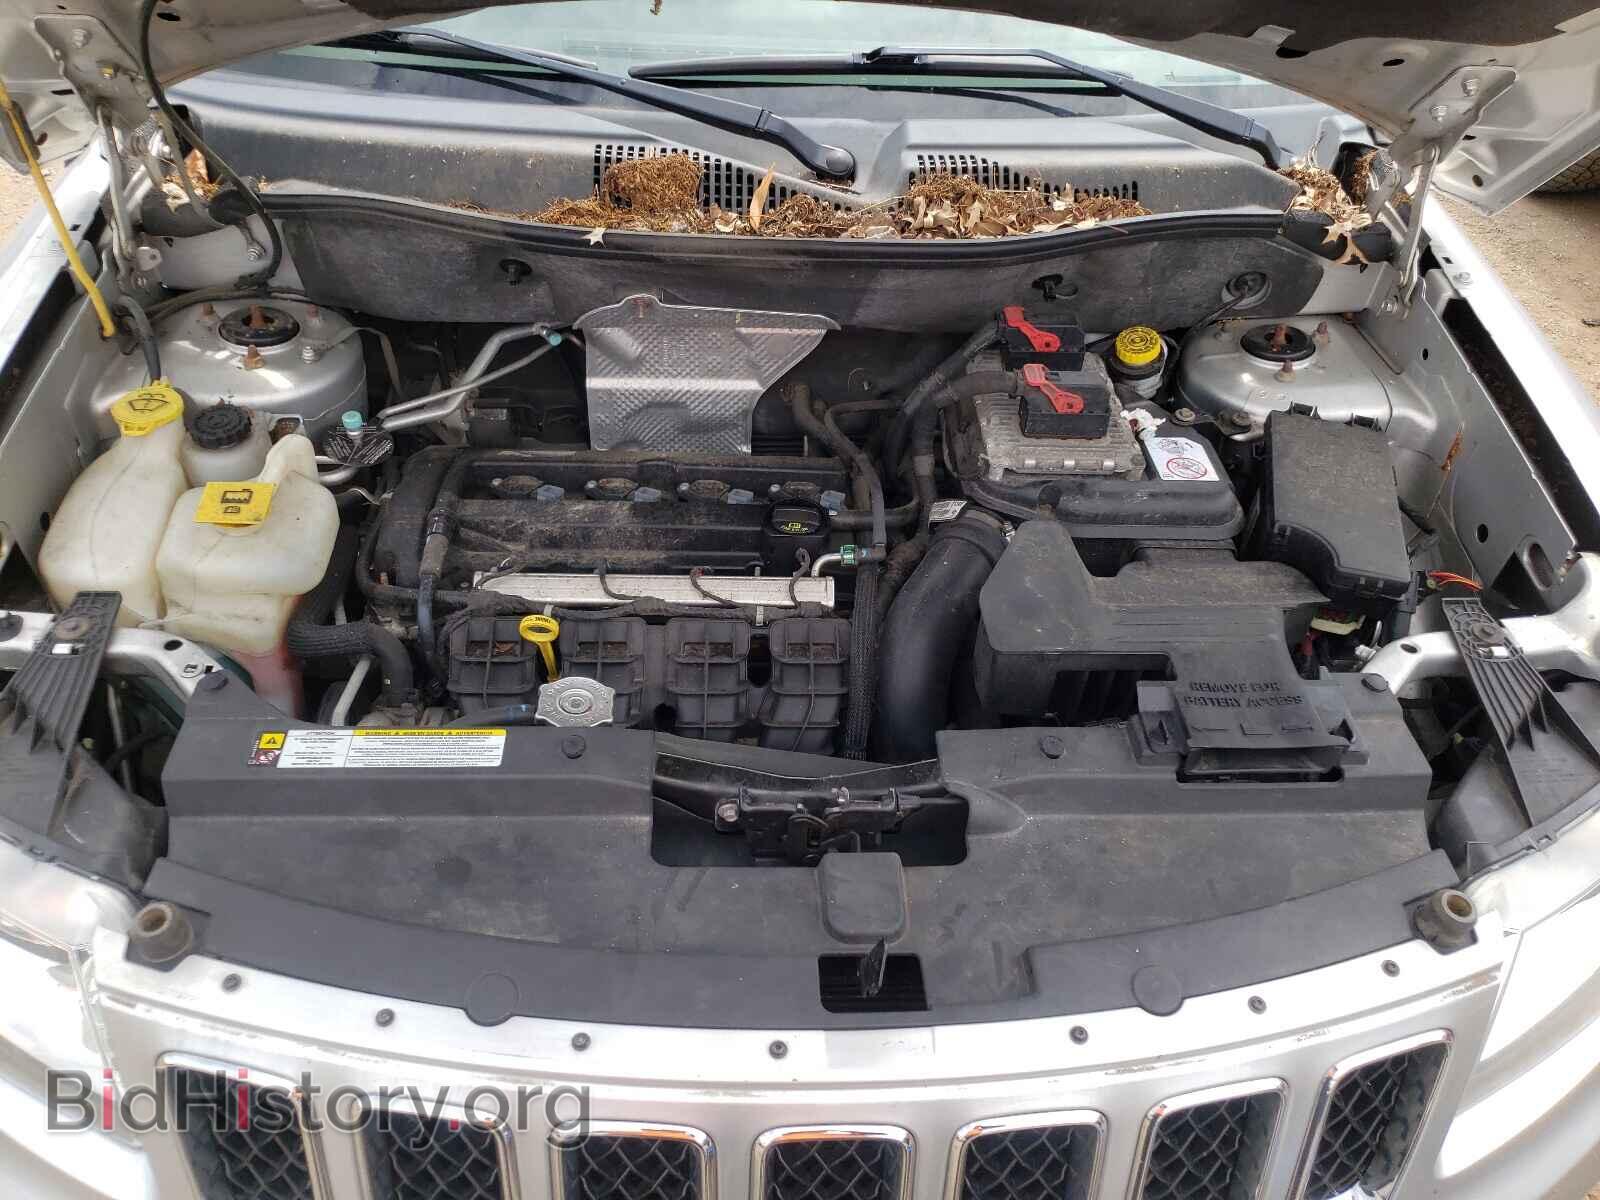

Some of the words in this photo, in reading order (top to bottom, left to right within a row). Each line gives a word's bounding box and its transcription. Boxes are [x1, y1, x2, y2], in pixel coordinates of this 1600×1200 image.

[1190, 681, 1247, 693] REMOVE
[1250, 681, 1281, 692] FOR
[1184, 696, 1241, 708] BATTERY
[1246, 696, 1305, 707] ACCESS
